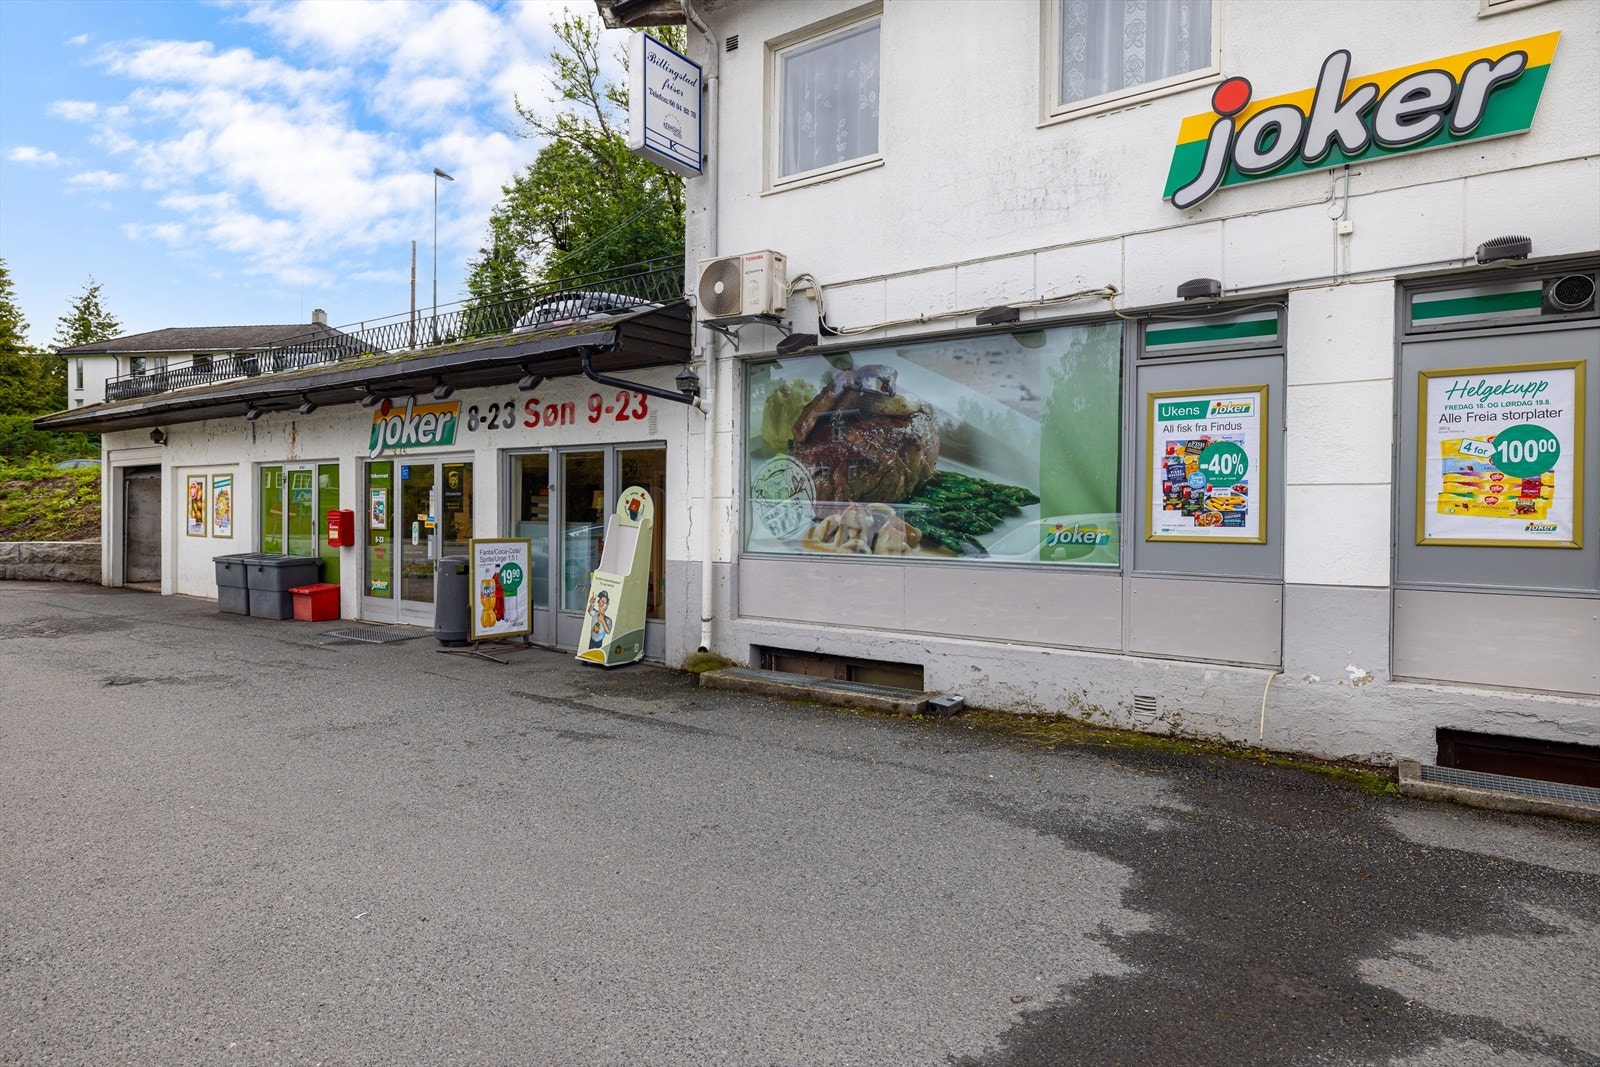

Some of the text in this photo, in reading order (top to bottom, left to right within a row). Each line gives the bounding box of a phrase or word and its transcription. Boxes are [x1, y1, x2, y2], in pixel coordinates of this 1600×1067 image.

[647, 51, 698, 88] Billingstad
[1171, 49, 1529, 210] joker
[1445, 379, 1549, 402] Helgekupp
[1162, 401, 1249, 417] Ukens joker
[1444, 403, 1474, 411] FREDAG
[1500, 400, 1533, 408] LØRDAG
[369, 390, 648, 460] joker 8-23 Søn 9-23
[1438, 408, 1564, 424] Alle Freia storplater
[1162, 422, 1242, 434] All fisk fra Findus
[1463, 441, 1489, 456] 4 for
[1200, 454, 1244, 475] -40%
[1048, 522, 1107, 547] joker
[1526, 522, 1557, 532] joker
